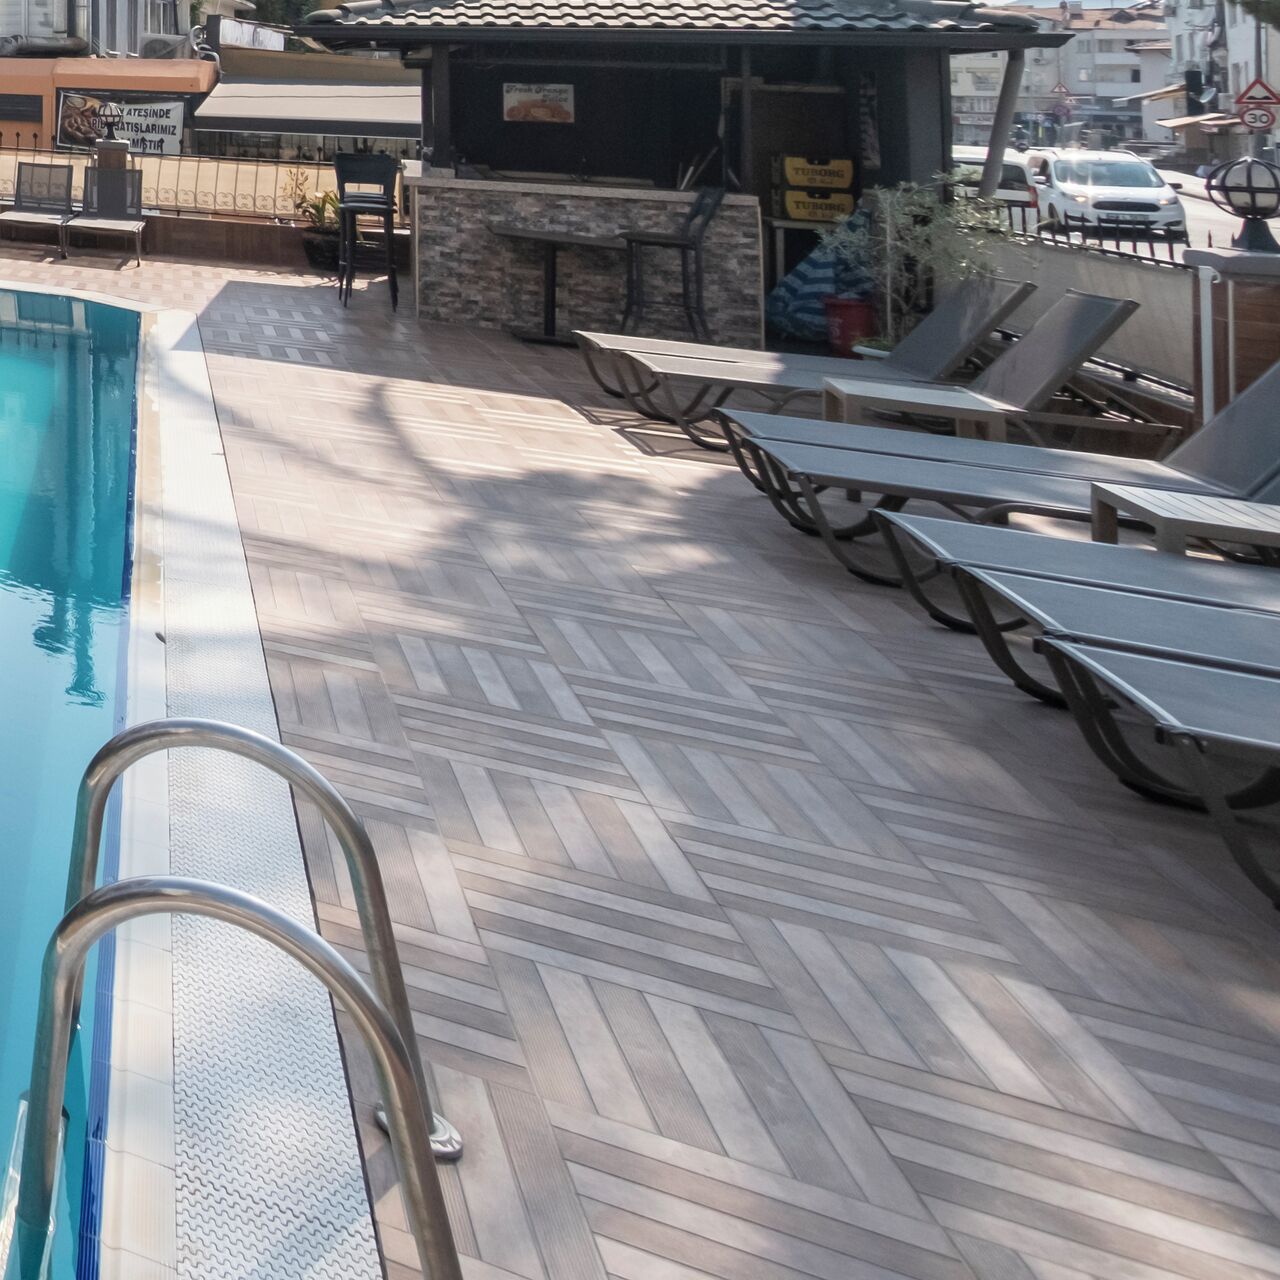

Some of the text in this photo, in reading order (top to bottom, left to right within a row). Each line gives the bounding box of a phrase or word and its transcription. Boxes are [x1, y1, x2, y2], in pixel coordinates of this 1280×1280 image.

[505, 84, 569, 96] Fresh Orange
[126, 106, 171, 120] ATEŞİNDE
[1248, 113, 1270, 124] 30
[793, 167, 845, 179] TUBORG
[793, 201, 846, 213] TUBORG
